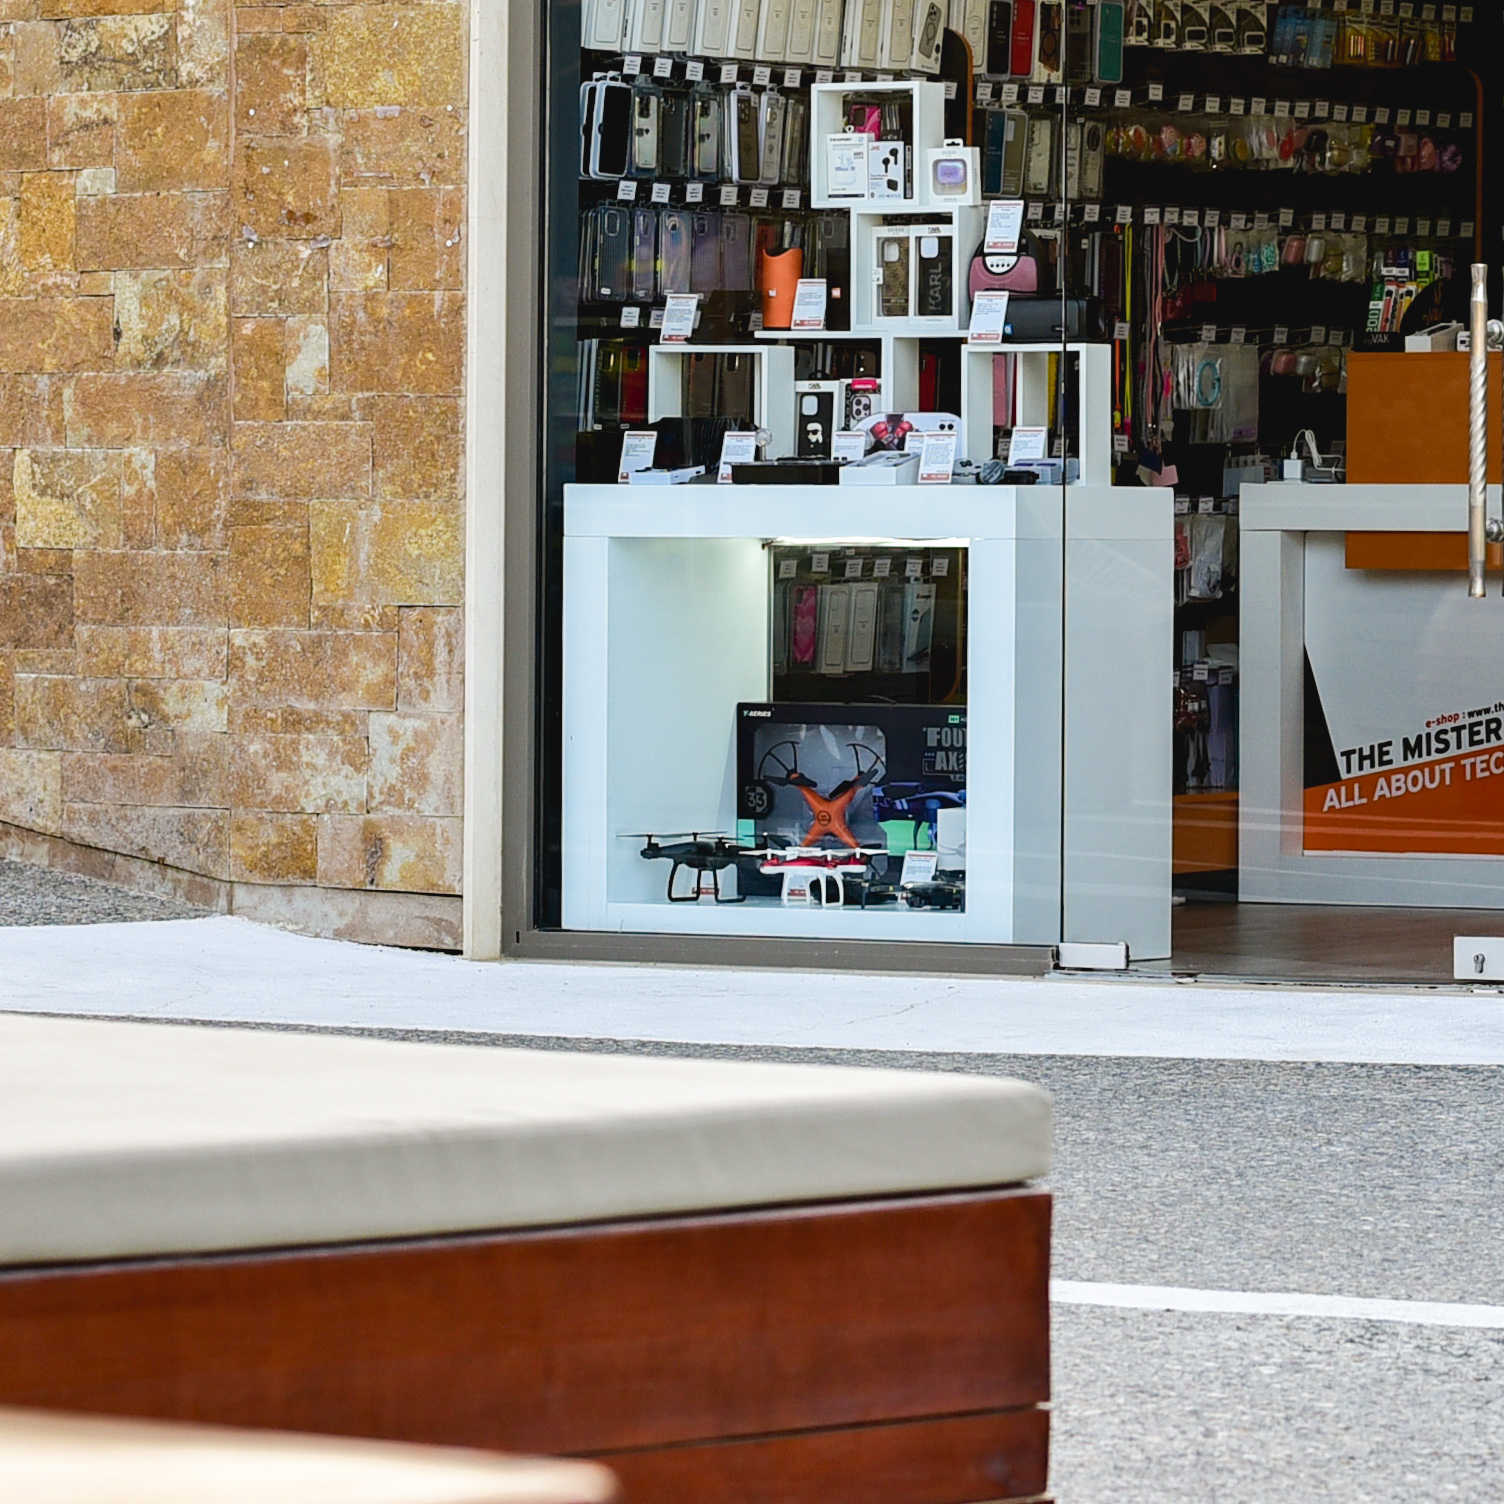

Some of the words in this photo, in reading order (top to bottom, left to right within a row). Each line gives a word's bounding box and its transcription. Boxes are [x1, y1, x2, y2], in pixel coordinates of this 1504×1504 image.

[928, 262, 943, 311] KARL
[926, 726, 968, 747] FOU
[1425, 712, 1460, 728] e-shop
[1340, 741, 1394, 775] THE
[1402, 717, 1502, 762] MISTER
[1322, 782, 1368, 813] ALL
[1373, 762, 1456, 802] ABOUT
